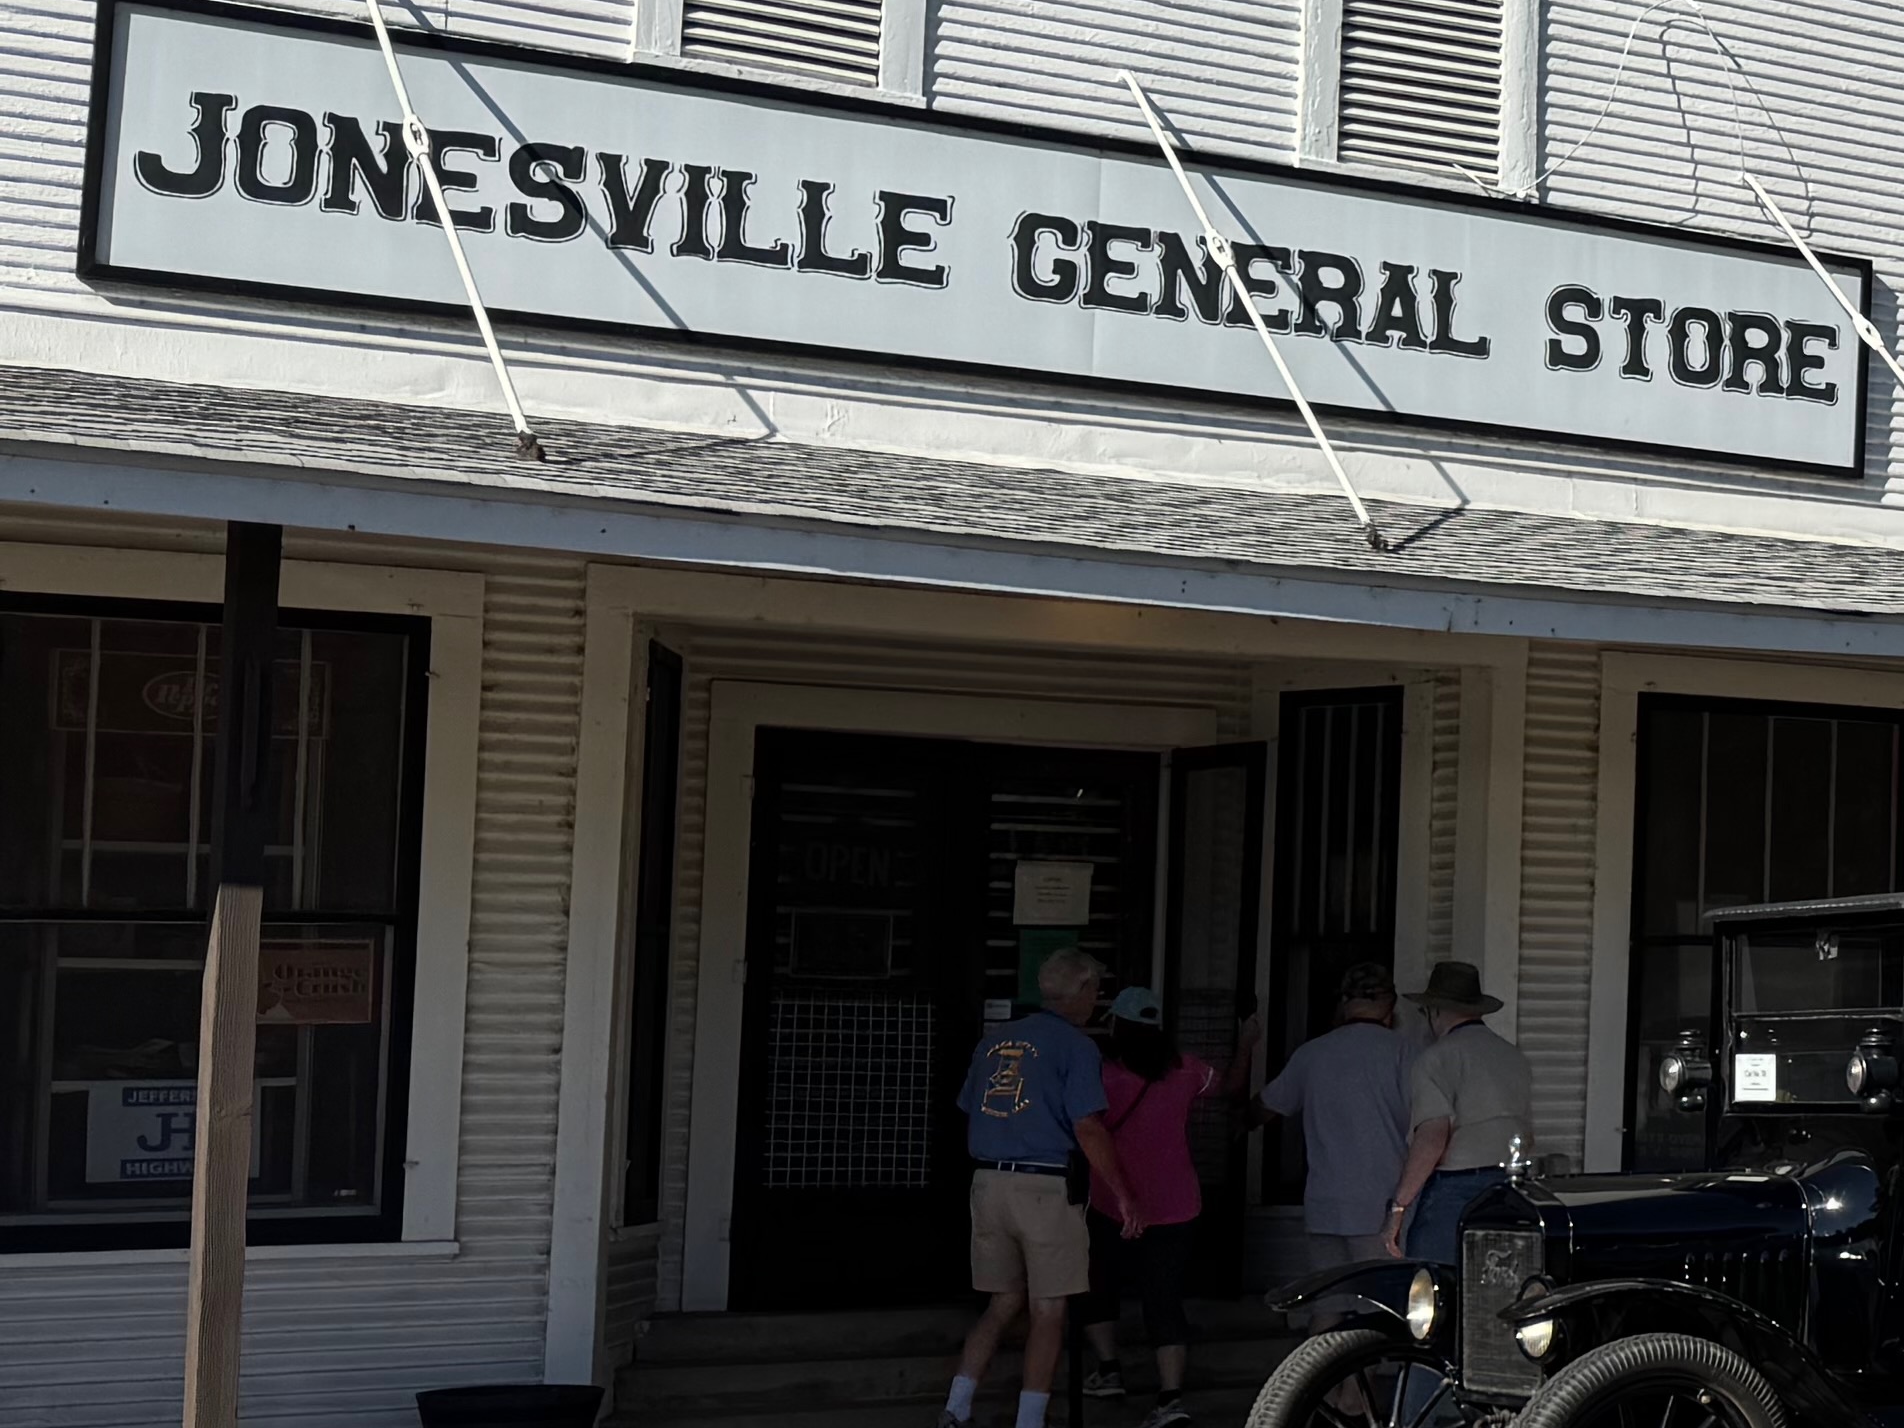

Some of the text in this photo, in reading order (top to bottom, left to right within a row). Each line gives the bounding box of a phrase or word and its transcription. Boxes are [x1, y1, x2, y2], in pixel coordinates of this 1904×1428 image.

[134, 90, 1842, 407] JONESVILLE GENERAL STORE
[803, 840, 892, 888] OPEN
[295, 980, 367, 997] Crush
[127, 1087, 197, 1103] JEFFER
[125, 1160, 194, 1176] HIGHW
